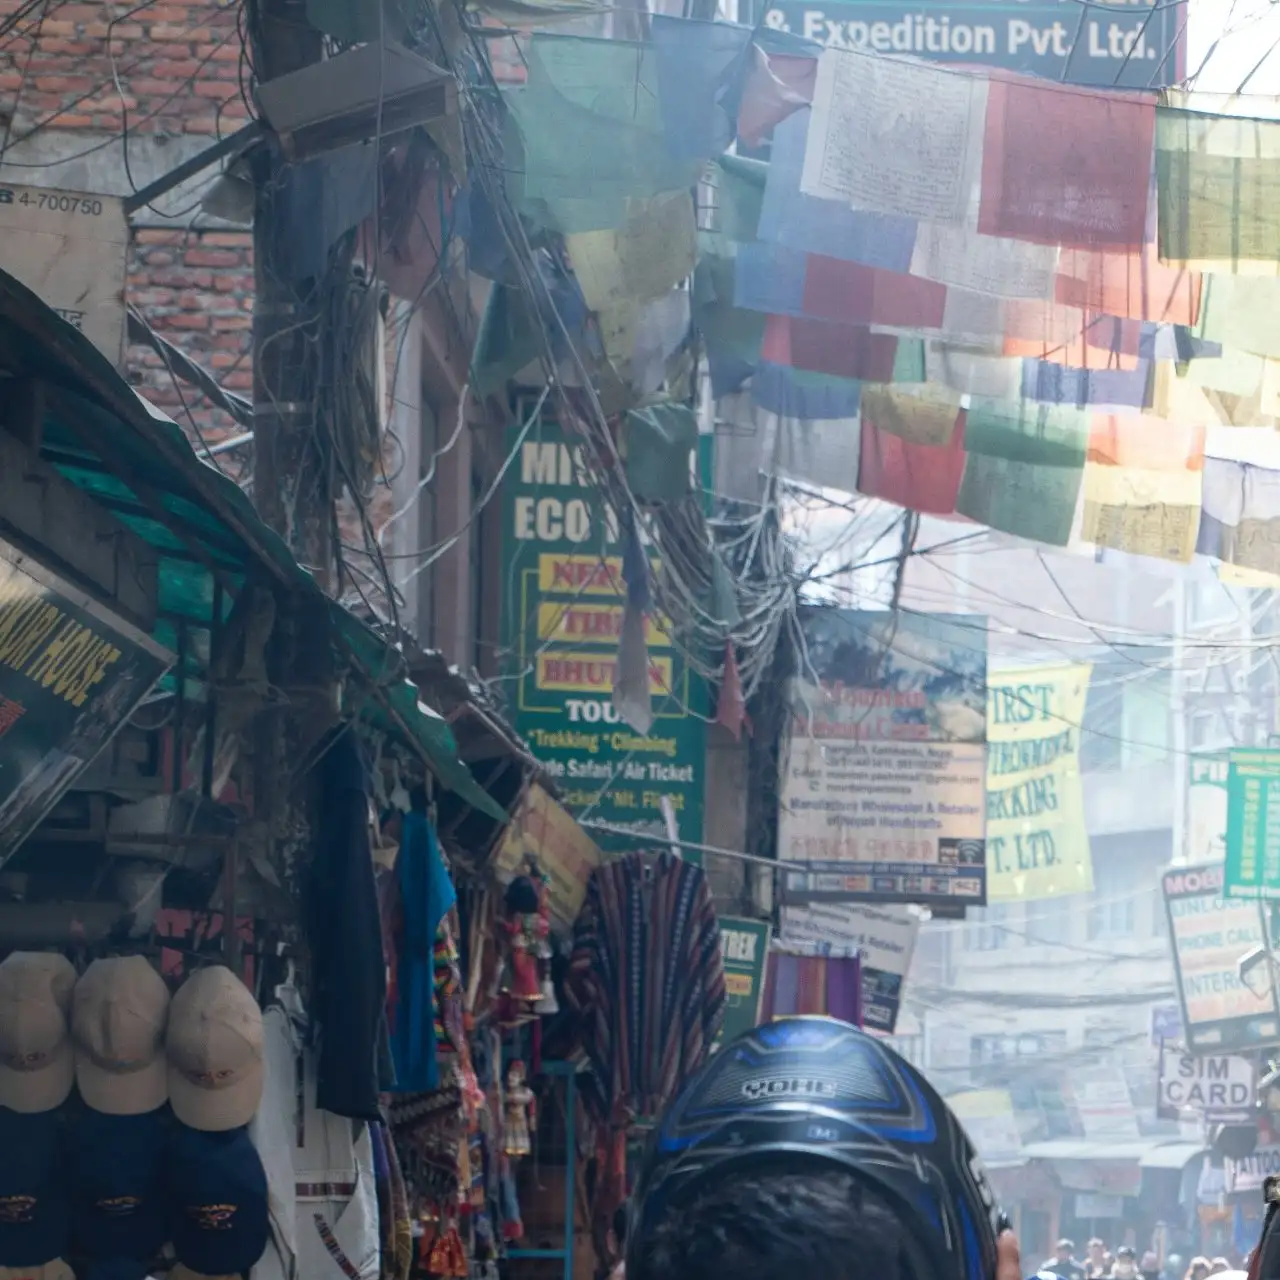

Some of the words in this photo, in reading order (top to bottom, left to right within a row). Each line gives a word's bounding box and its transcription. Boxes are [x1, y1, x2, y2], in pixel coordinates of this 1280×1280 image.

[804, 11, 996, 56] Expedition
[1007, 20, 1073, 57] Pvt.
[1088, 21, 1156, 59] Ltd.
[18, 192, 102, 216] 4-700750
[514, 496, 592, 543] ECO
[25, 618, 122, 707] HOUSE
[565, 700, 628, 723] TOU
[993, 684, 1055, 725] IRST
[987, 773, 1058, 819] EKKING
[1178, 1057, 1230, 1081] SIM
[1166, 1080, 1249, 1105] CARD
